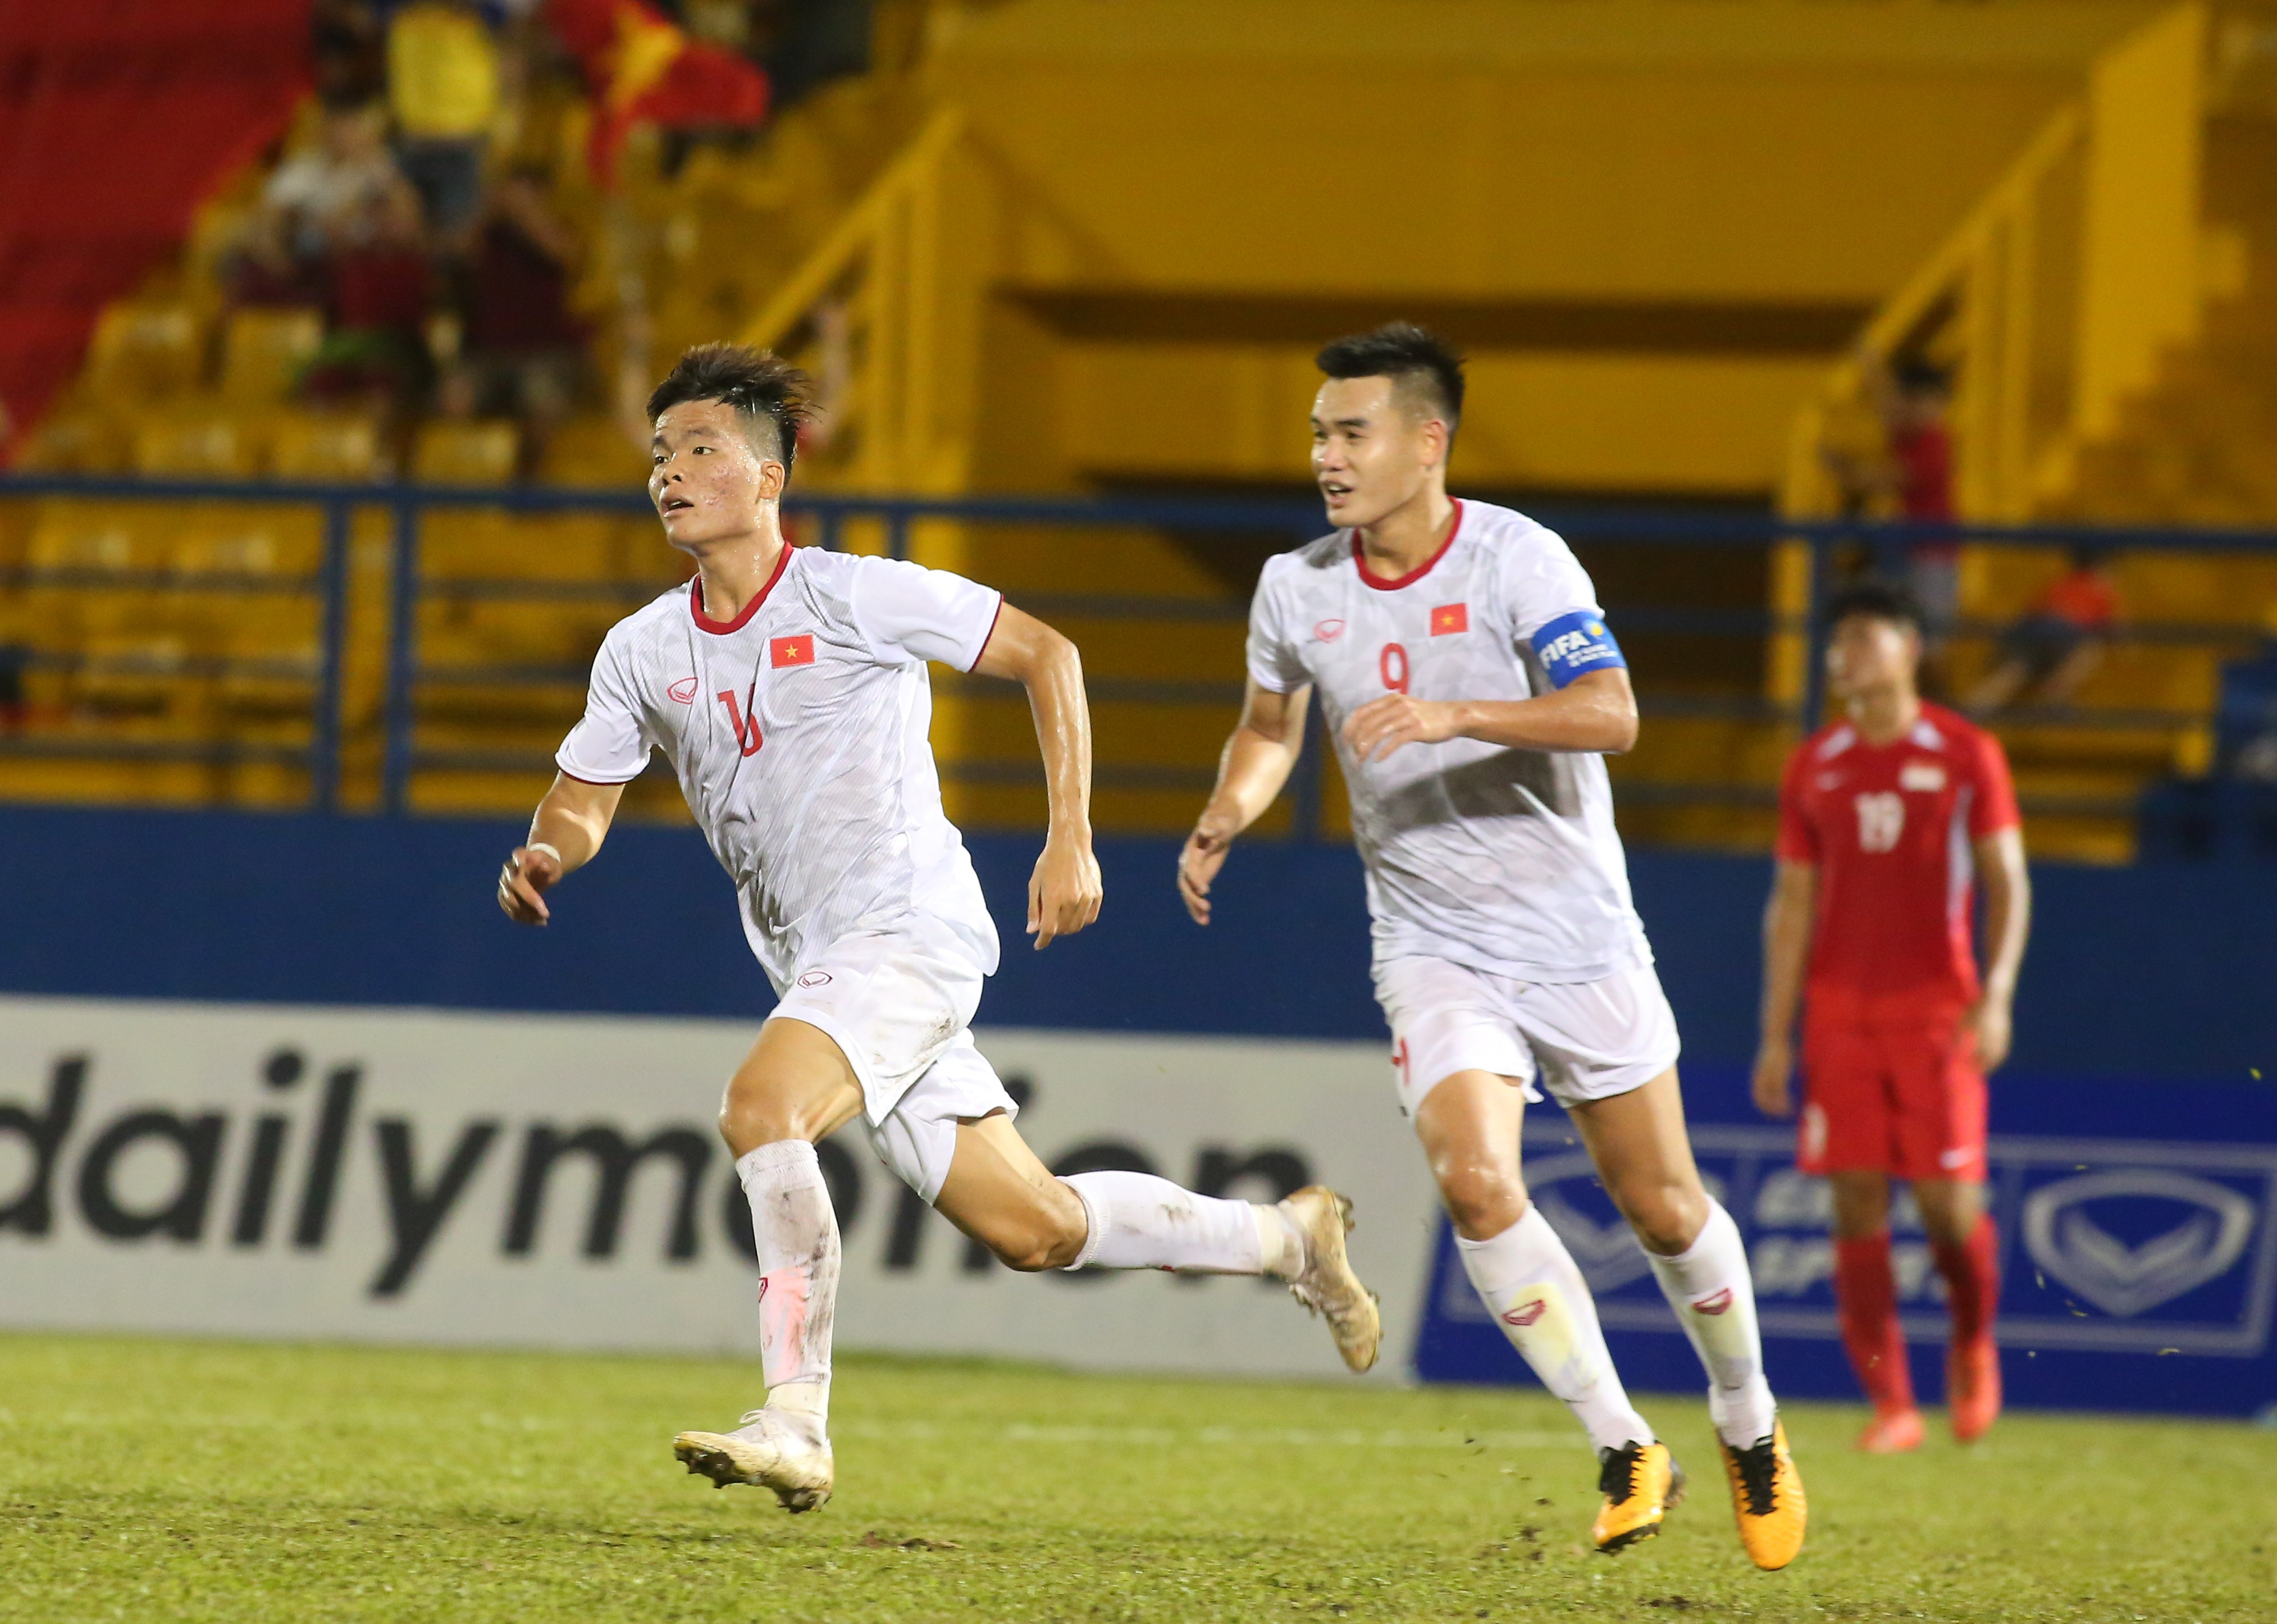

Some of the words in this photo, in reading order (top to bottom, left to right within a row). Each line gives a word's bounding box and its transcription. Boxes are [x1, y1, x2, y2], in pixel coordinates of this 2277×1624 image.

[1380, 642, 1410, 695] 9
[1540, 630, 1591, 669] FIFA
[717, 682, 763, 757] 16
[1855, 793, 1905, 854] 19
